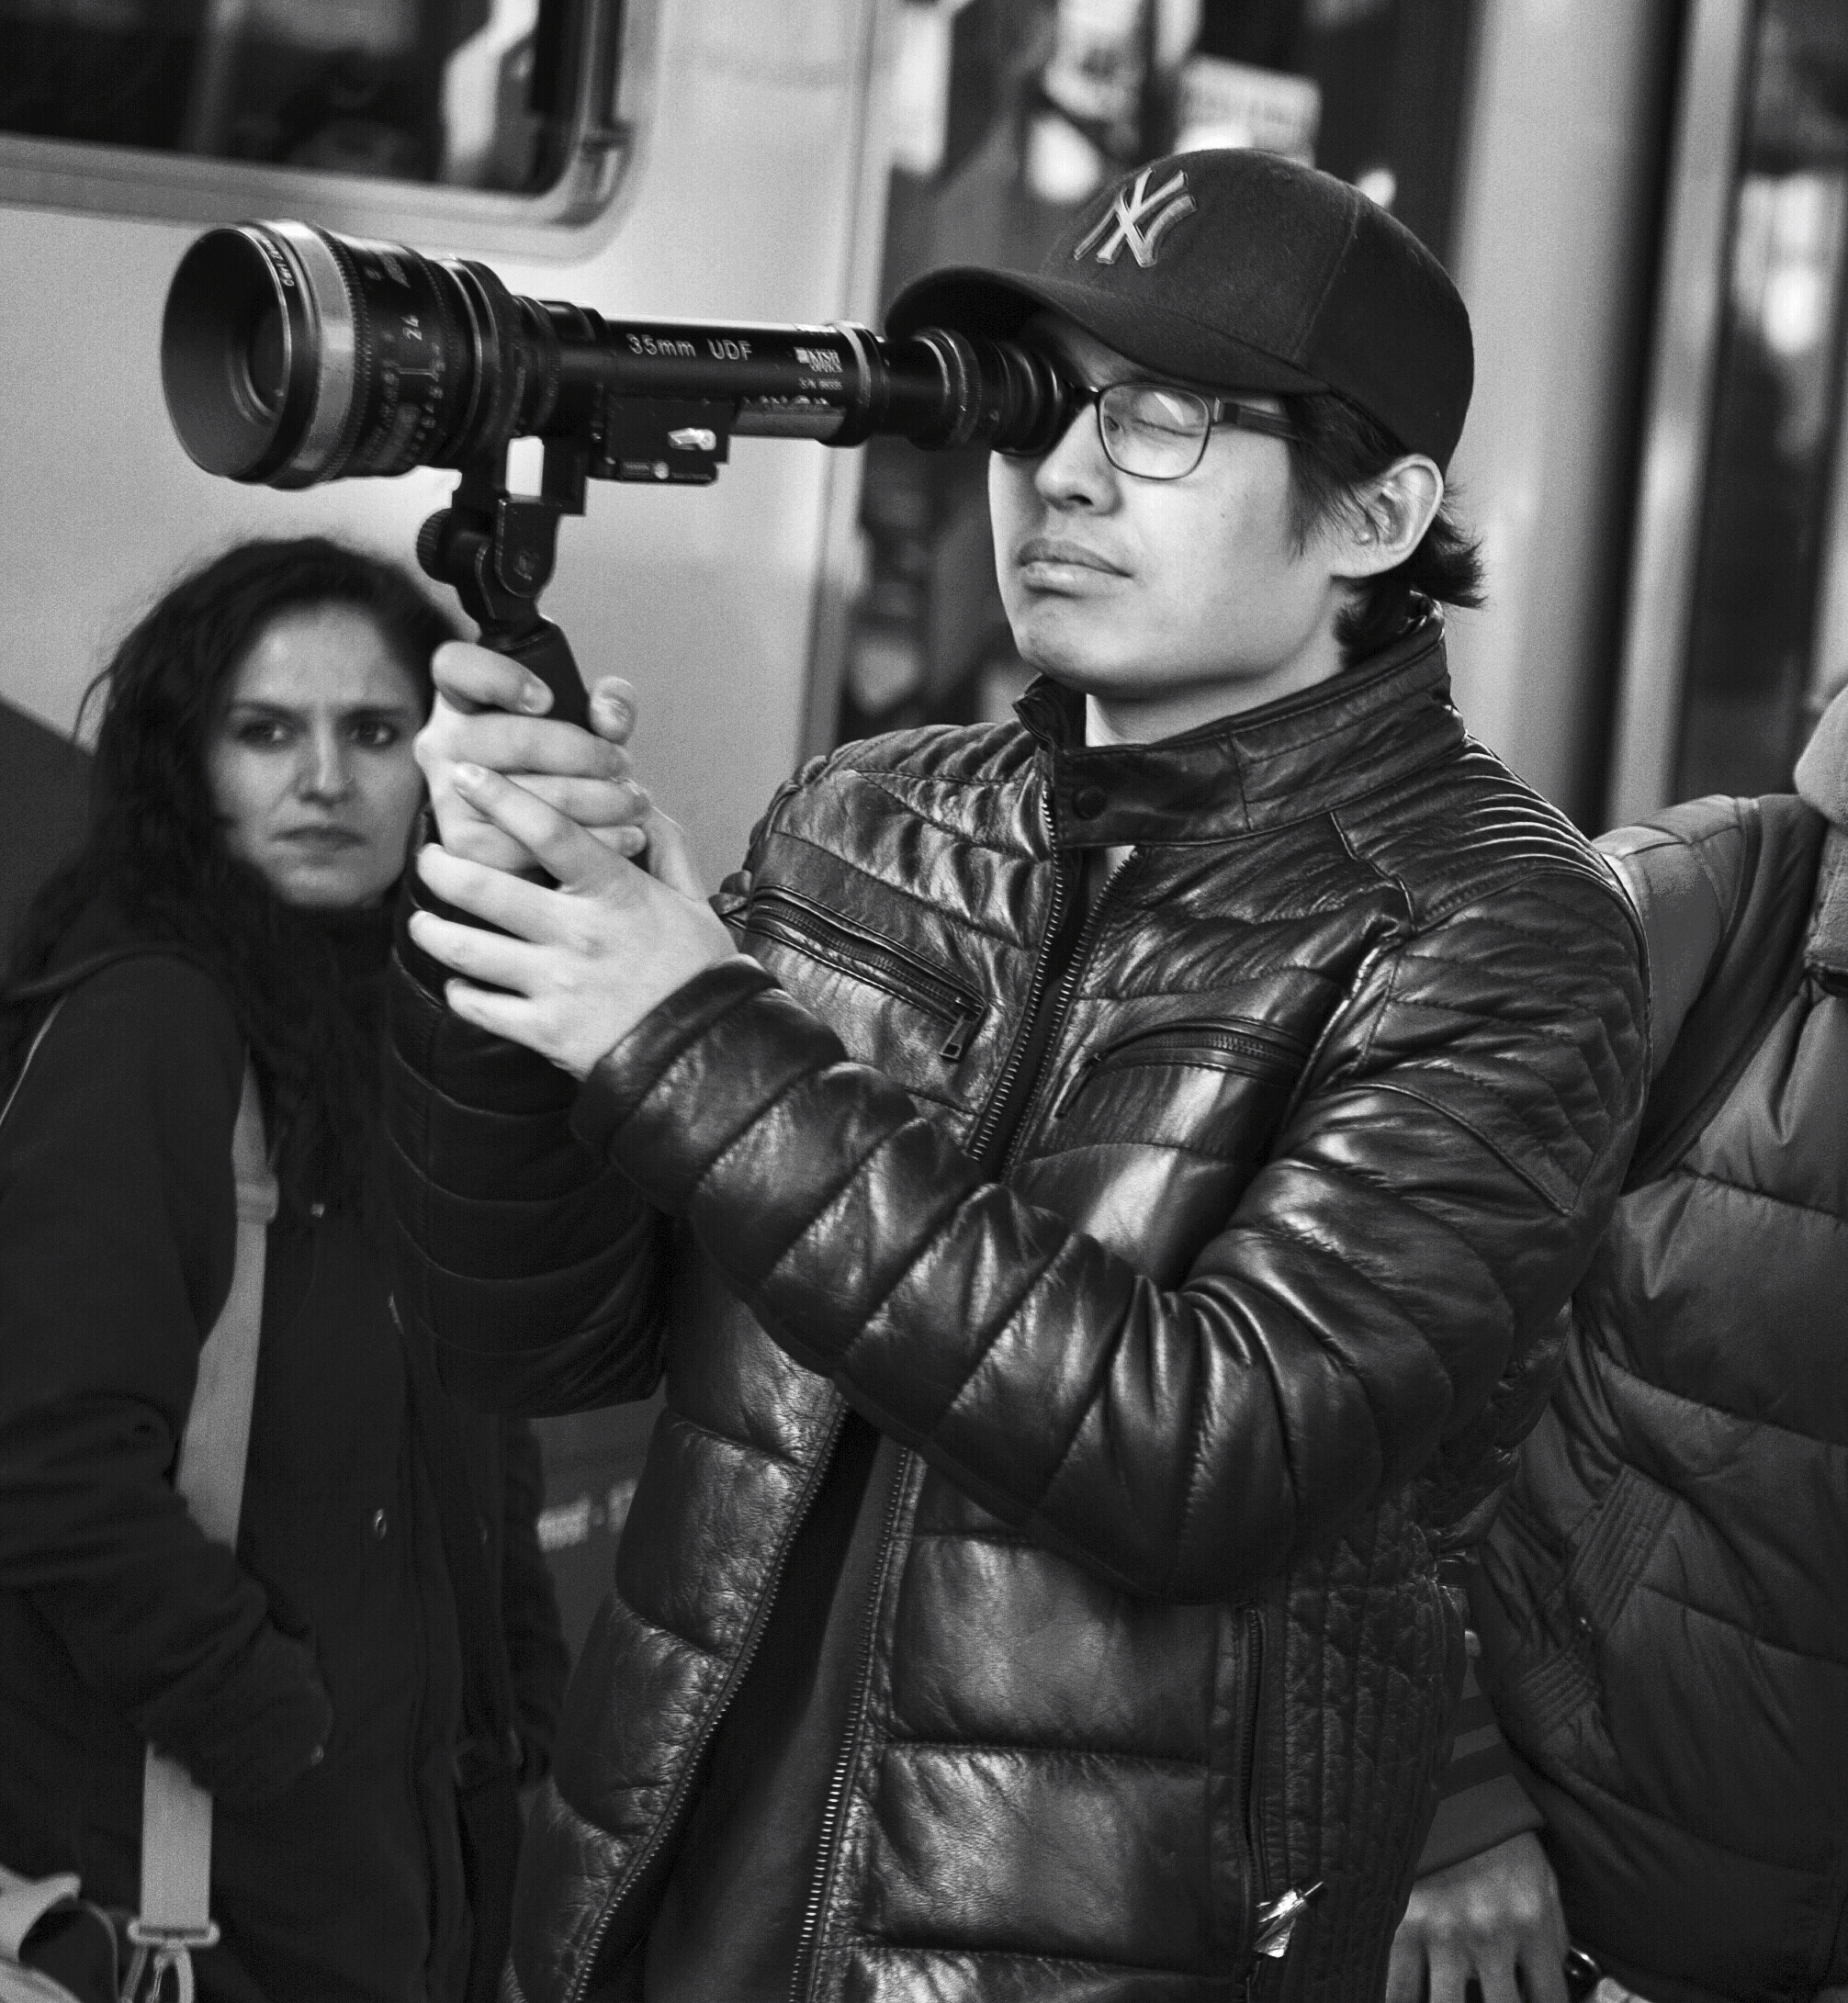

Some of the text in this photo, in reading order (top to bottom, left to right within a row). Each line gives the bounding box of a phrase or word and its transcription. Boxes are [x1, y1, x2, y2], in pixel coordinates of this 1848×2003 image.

[1074, 167, 1198, 267] NY
[625, 333, 752, 360] 35mm UDF
